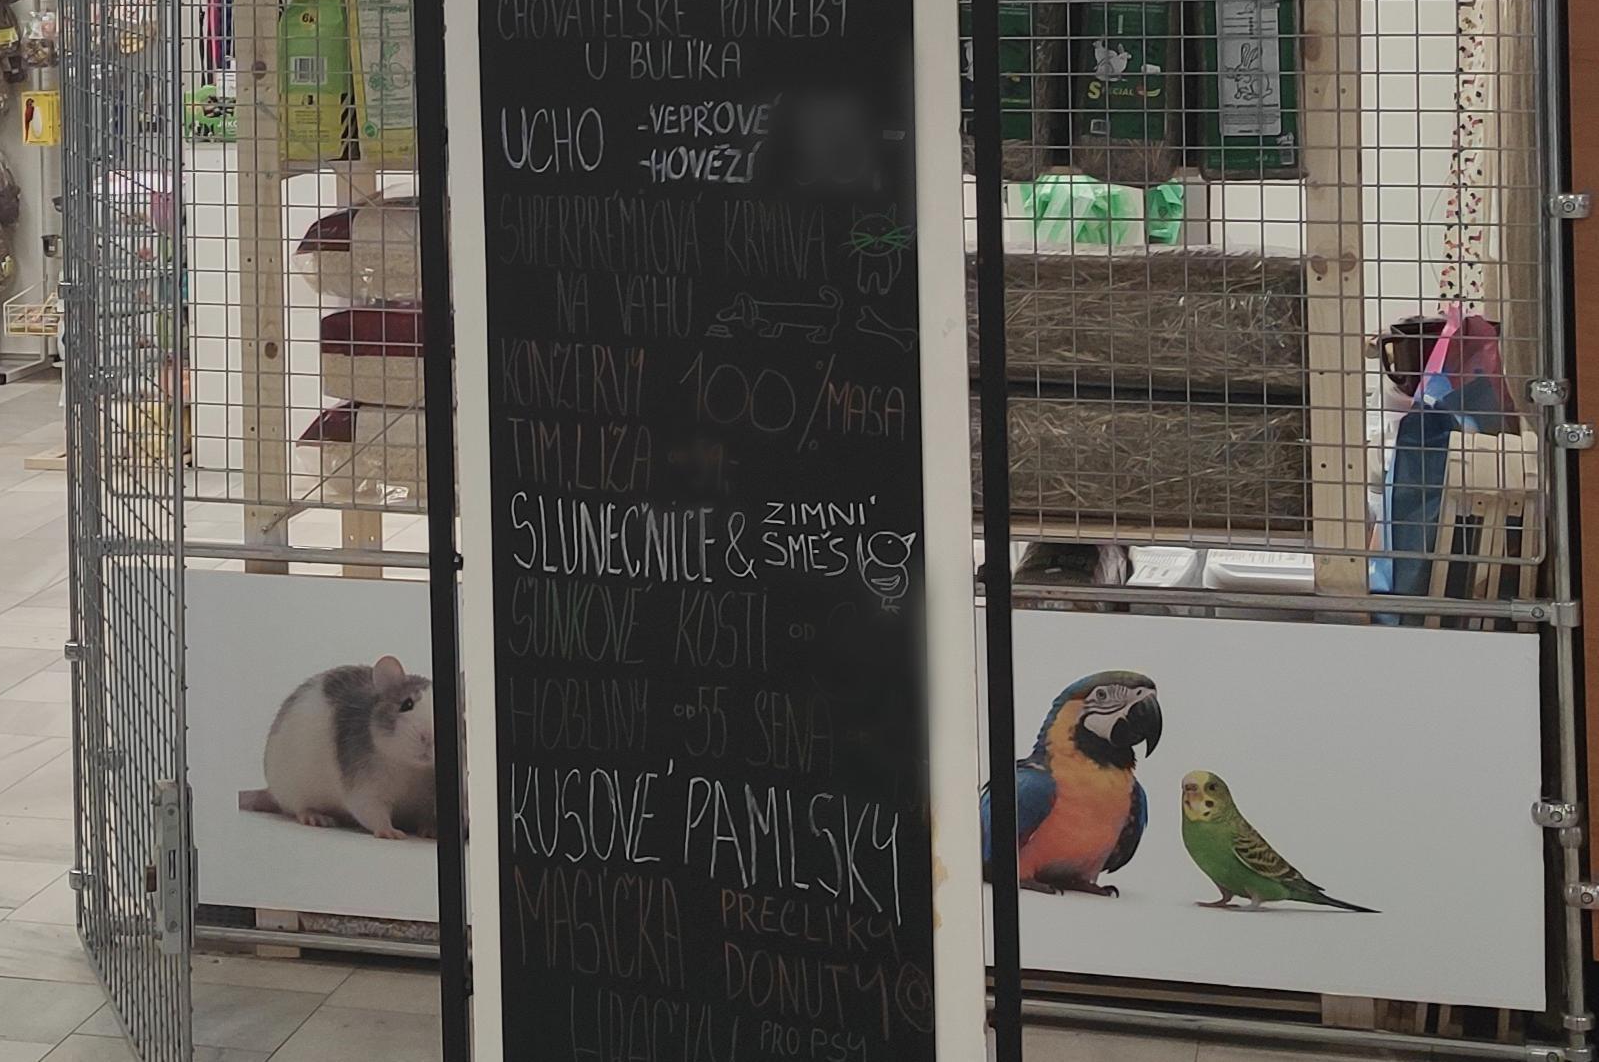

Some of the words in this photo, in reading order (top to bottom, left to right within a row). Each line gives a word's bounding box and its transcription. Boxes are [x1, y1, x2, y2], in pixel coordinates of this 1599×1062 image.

[585, 41, 607, 80] U
[629, 39, 741, 80] BULÍKA
[501, 106, 604, 173] UCHO
[723, 198, 829, 280] KRMIVA
[557, 269, 590, 335] NA
[615, 272, 693, 338] VÁHU
[500, 337, 646, 417] KONZERVY
[827, 381, 905, 441] MASA
[510, 490, 715, 584] SLUNEČNICE
[725, 511, 758, 581] &
[762, 494, 877, 528] ZIMNÍ
[762, 529, 849, 577] SMĚS
[673, 587, 769, 673] KOSTI
[509, 675, 649, 752] HOBLINY
[510, 758, 675, 863] KUSOVÉ
[684, 776, 901, 926] PAMLSKY
[514, 865, 685, 989] MASÍČKA
[720, 887, 899, 959] PRECLÍKY
[724, 940, 890, 1040] DONUTY
[760, 1020, 800, 1056] PRO
